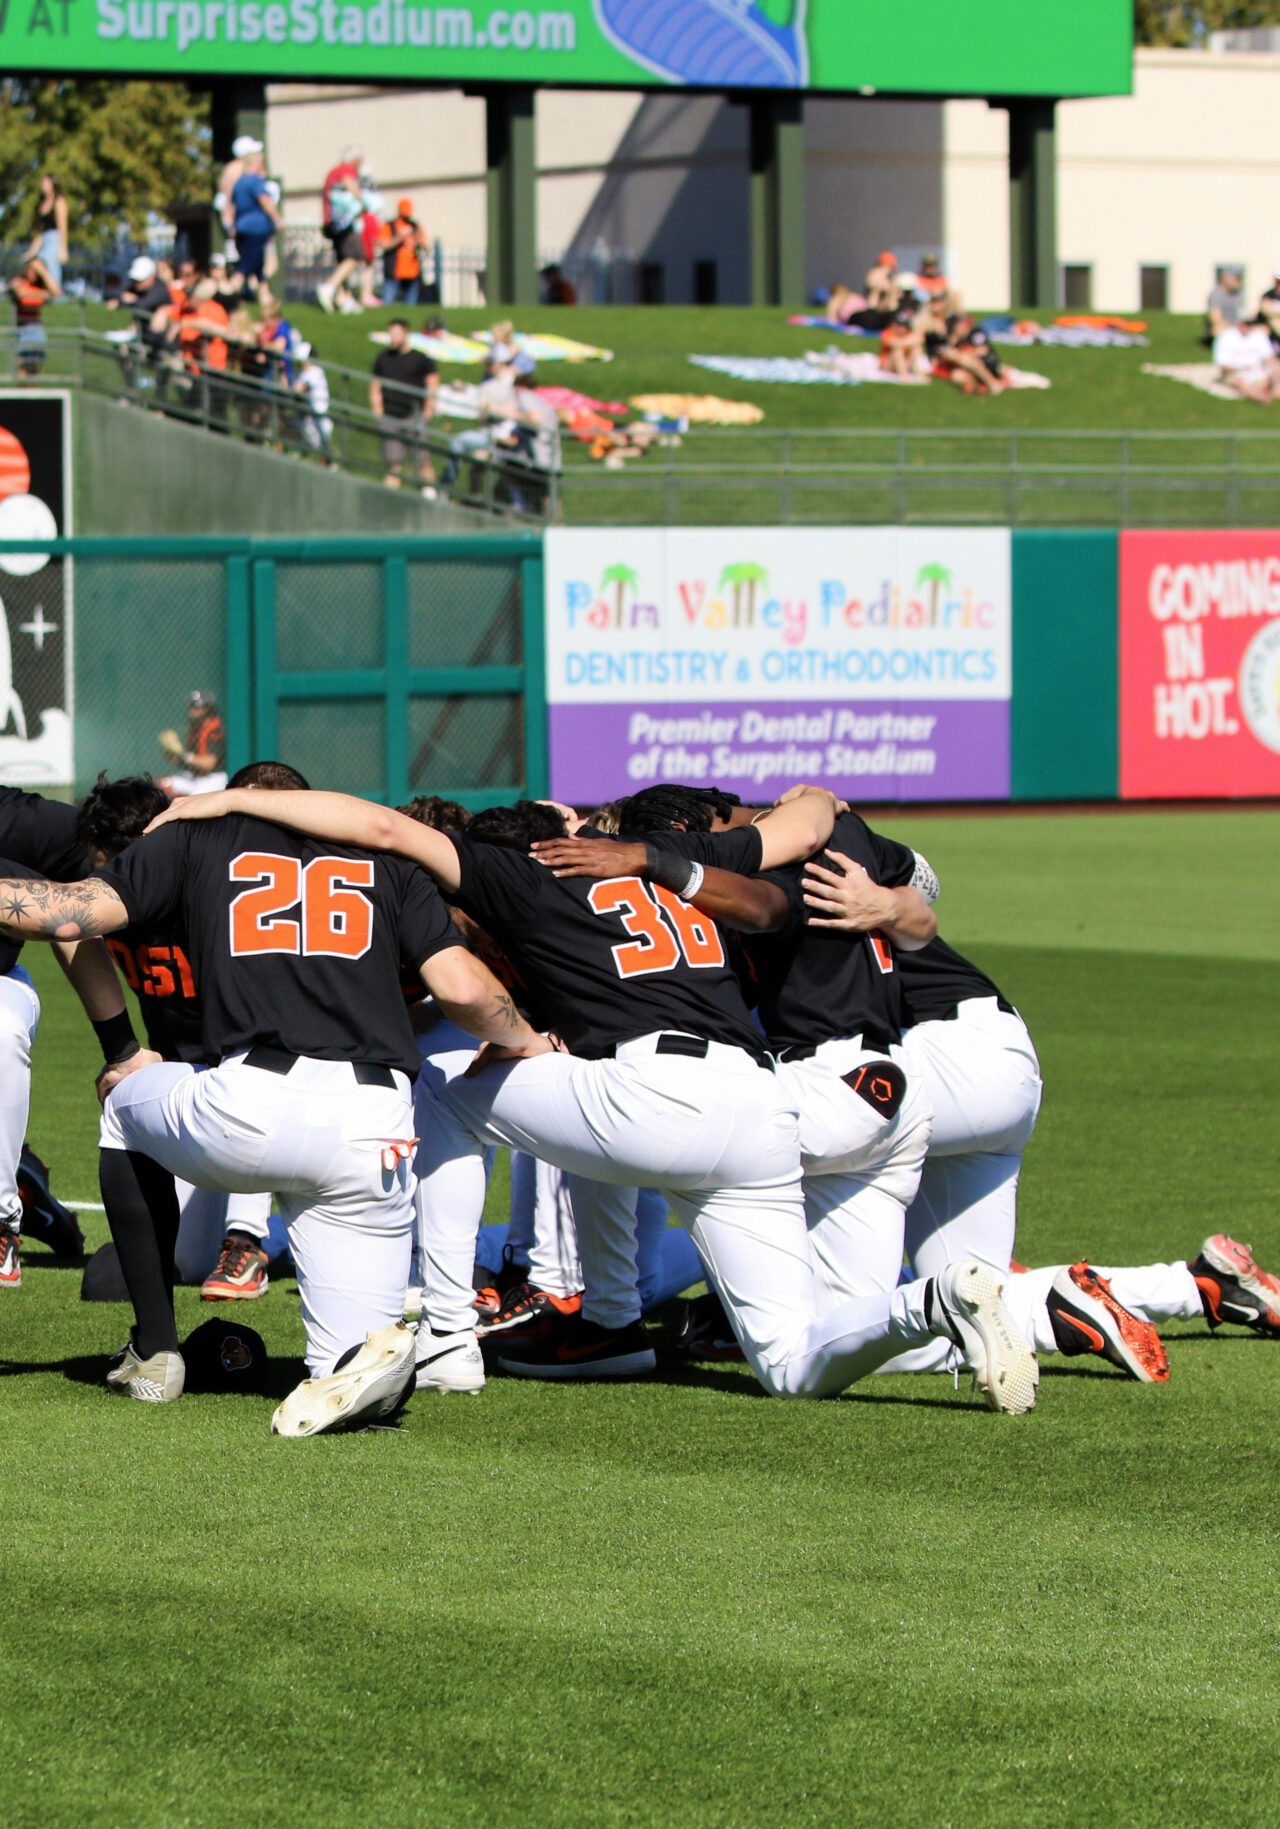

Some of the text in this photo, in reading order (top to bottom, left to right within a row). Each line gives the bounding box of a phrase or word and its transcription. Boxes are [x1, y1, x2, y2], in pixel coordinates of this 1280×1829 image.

[27, 0, 76, 36] AT
[96, 0, 578, 52] SurpriseStadium.com
[564, 563, 996, 645] Palm Valley Pediatric
[1149, 557, 1280, 621] COMING
[566, 649, 997, 685] DENTISTRY & ORTHODONTICS
[1163, 622, 1204, 680] IN
[628, 709, 936, 744] Premier Dental Partner
[1154, 678, 1239, 739] HOT.
[627, 742, 936, 785] of the Surprise Stadium
[228, 852, 375, 960] 26
